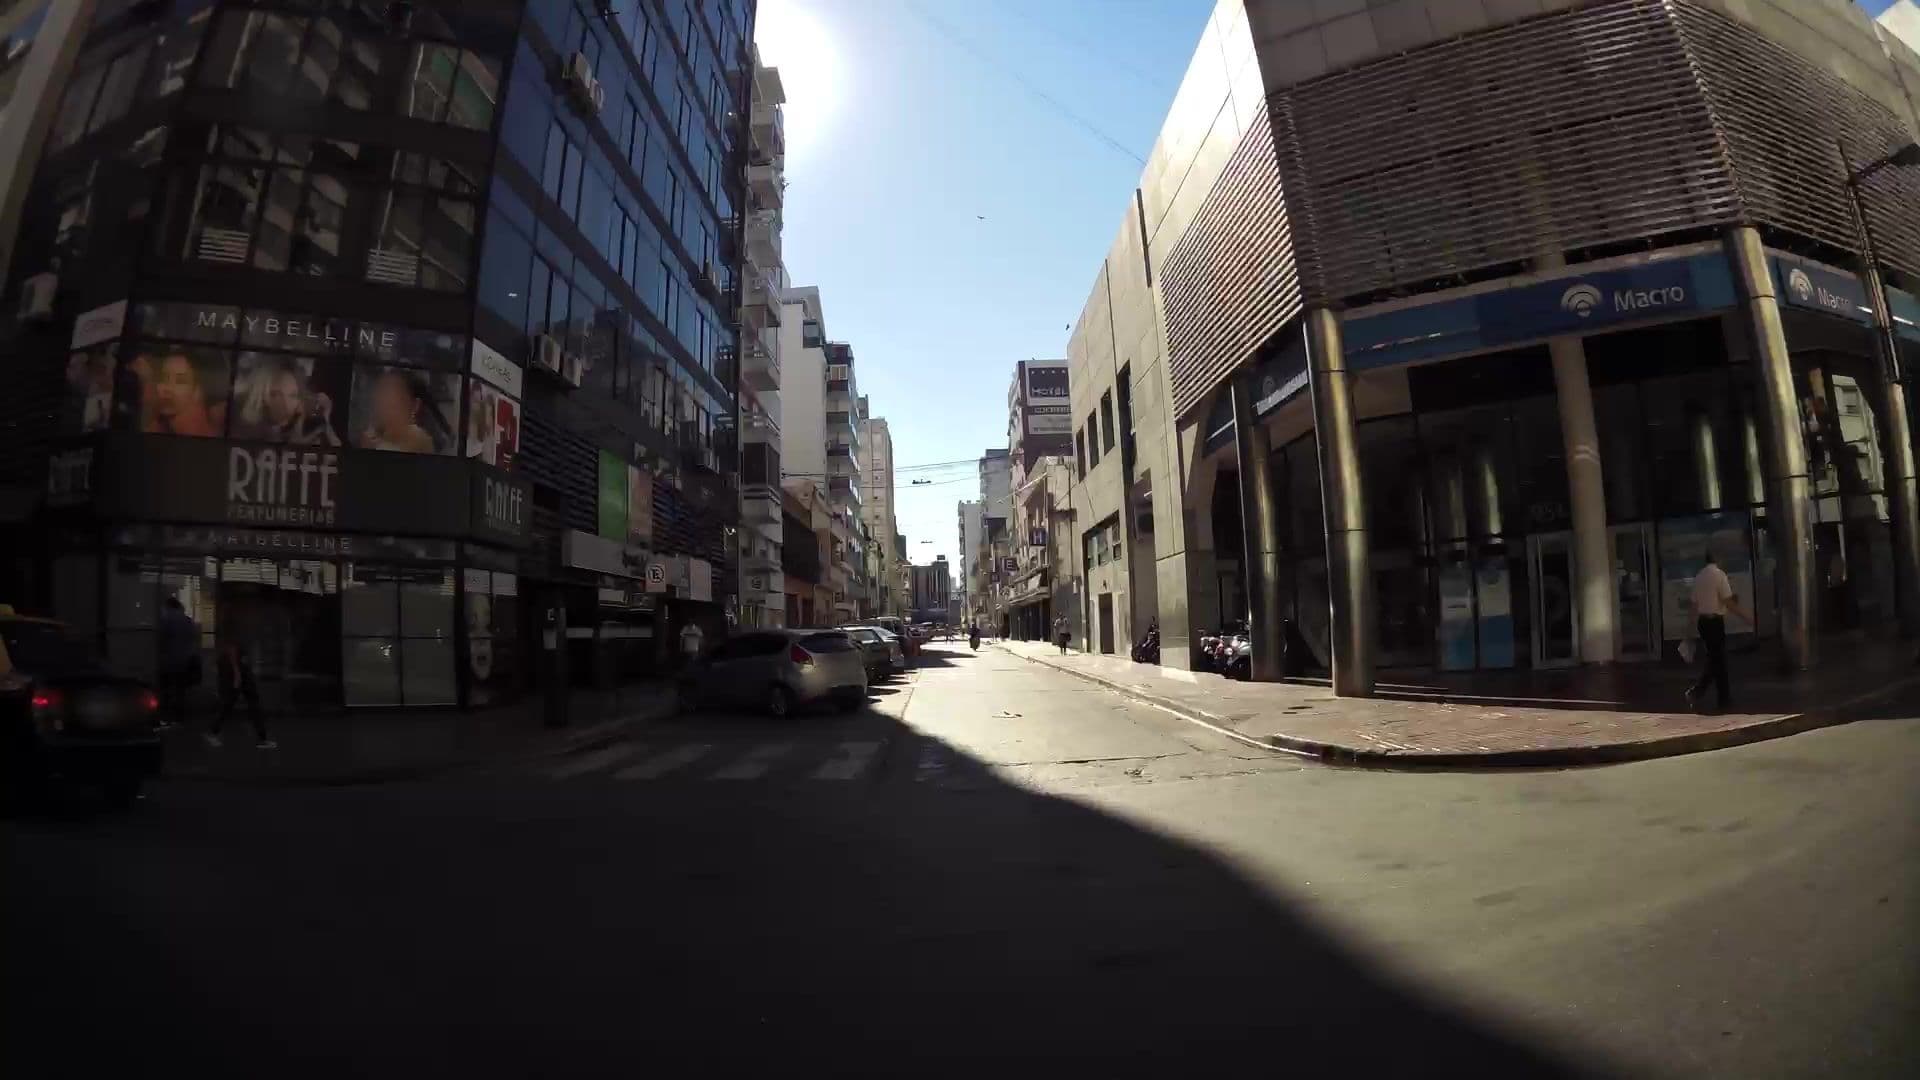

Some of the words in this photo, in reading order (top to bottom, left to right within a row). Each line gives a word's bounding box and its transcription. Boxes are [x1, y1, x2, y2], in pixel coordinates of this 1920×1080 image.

[1613, 286, 1685, 312] Macro
[196, 310, 397, 348] MAYBELLINE
[228, 446, 338, 507] RAFFE
